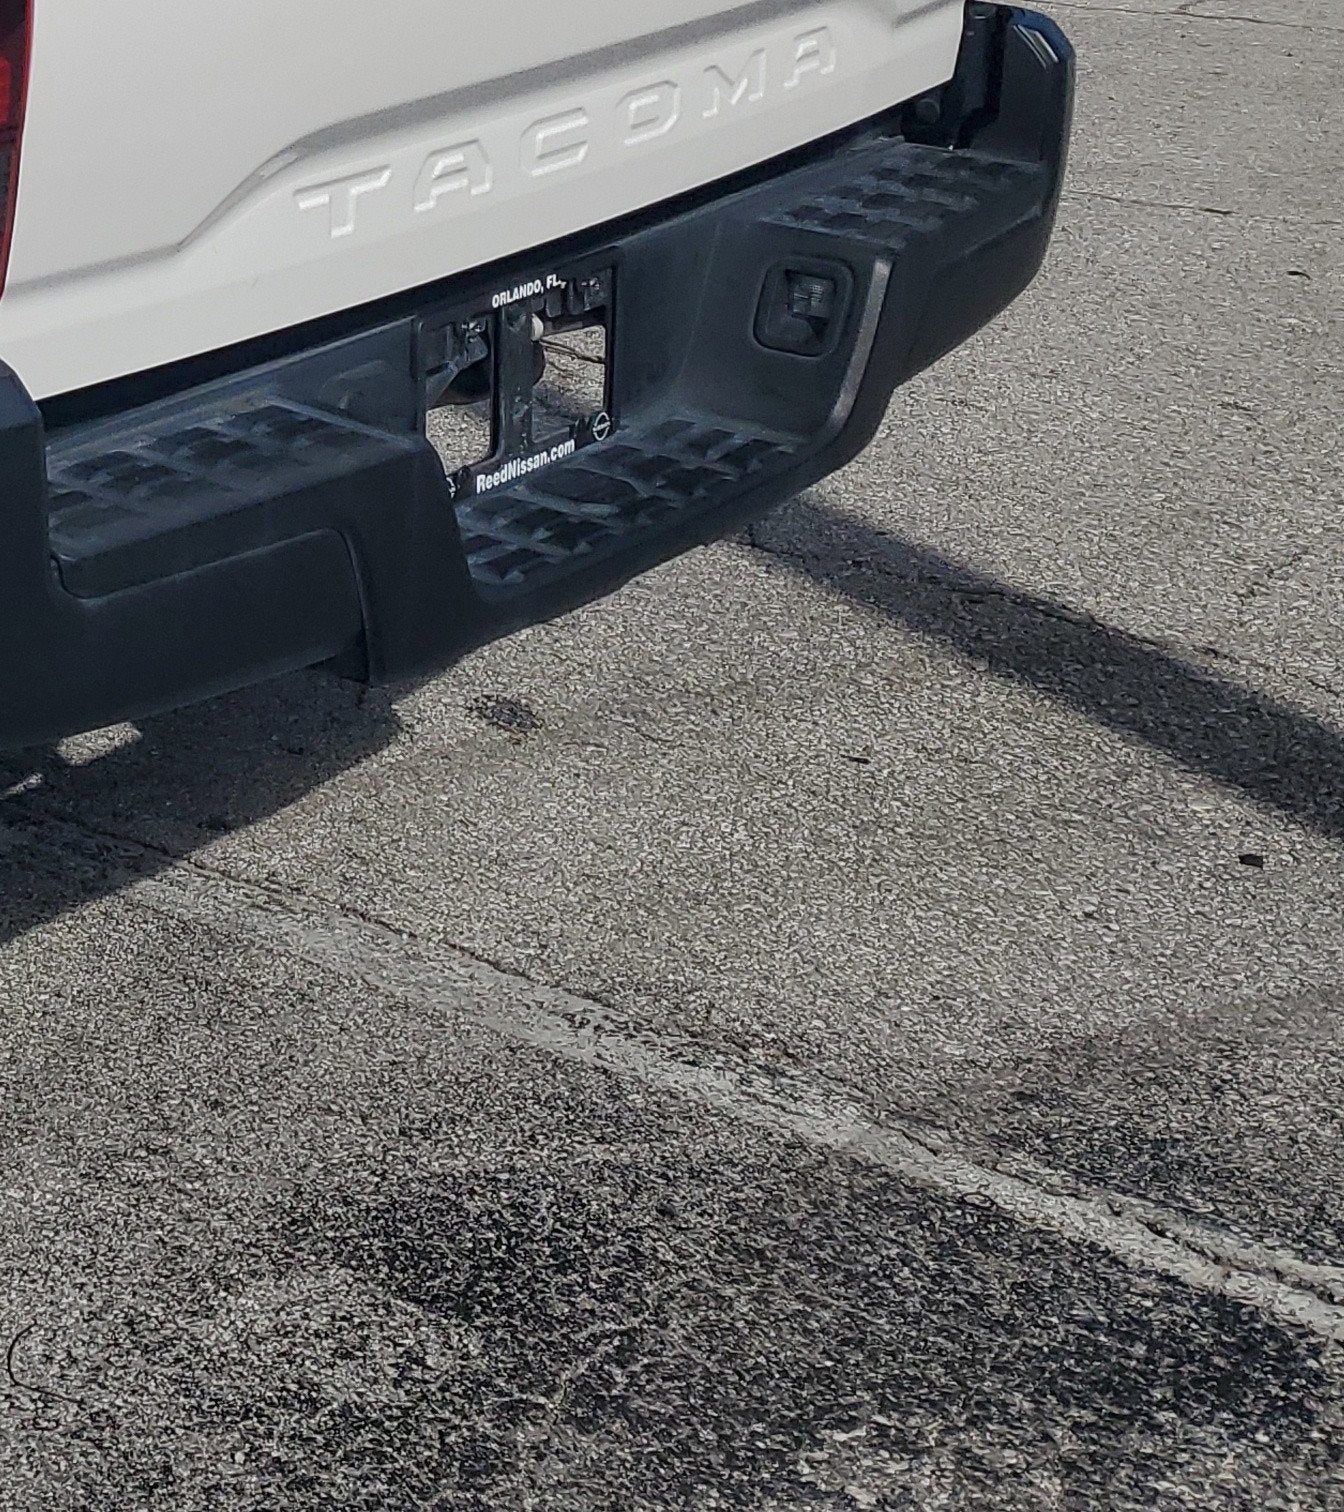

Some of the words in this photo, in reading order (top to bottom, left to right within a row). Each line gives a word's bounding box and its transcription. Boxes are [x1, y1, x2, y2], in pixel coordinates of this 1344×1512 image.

[293, 25, 836, 238] TACOMA
[492, 279, 544, 308] ORLANDO,
[476, 438, 576, 495] ReedNissan.com
